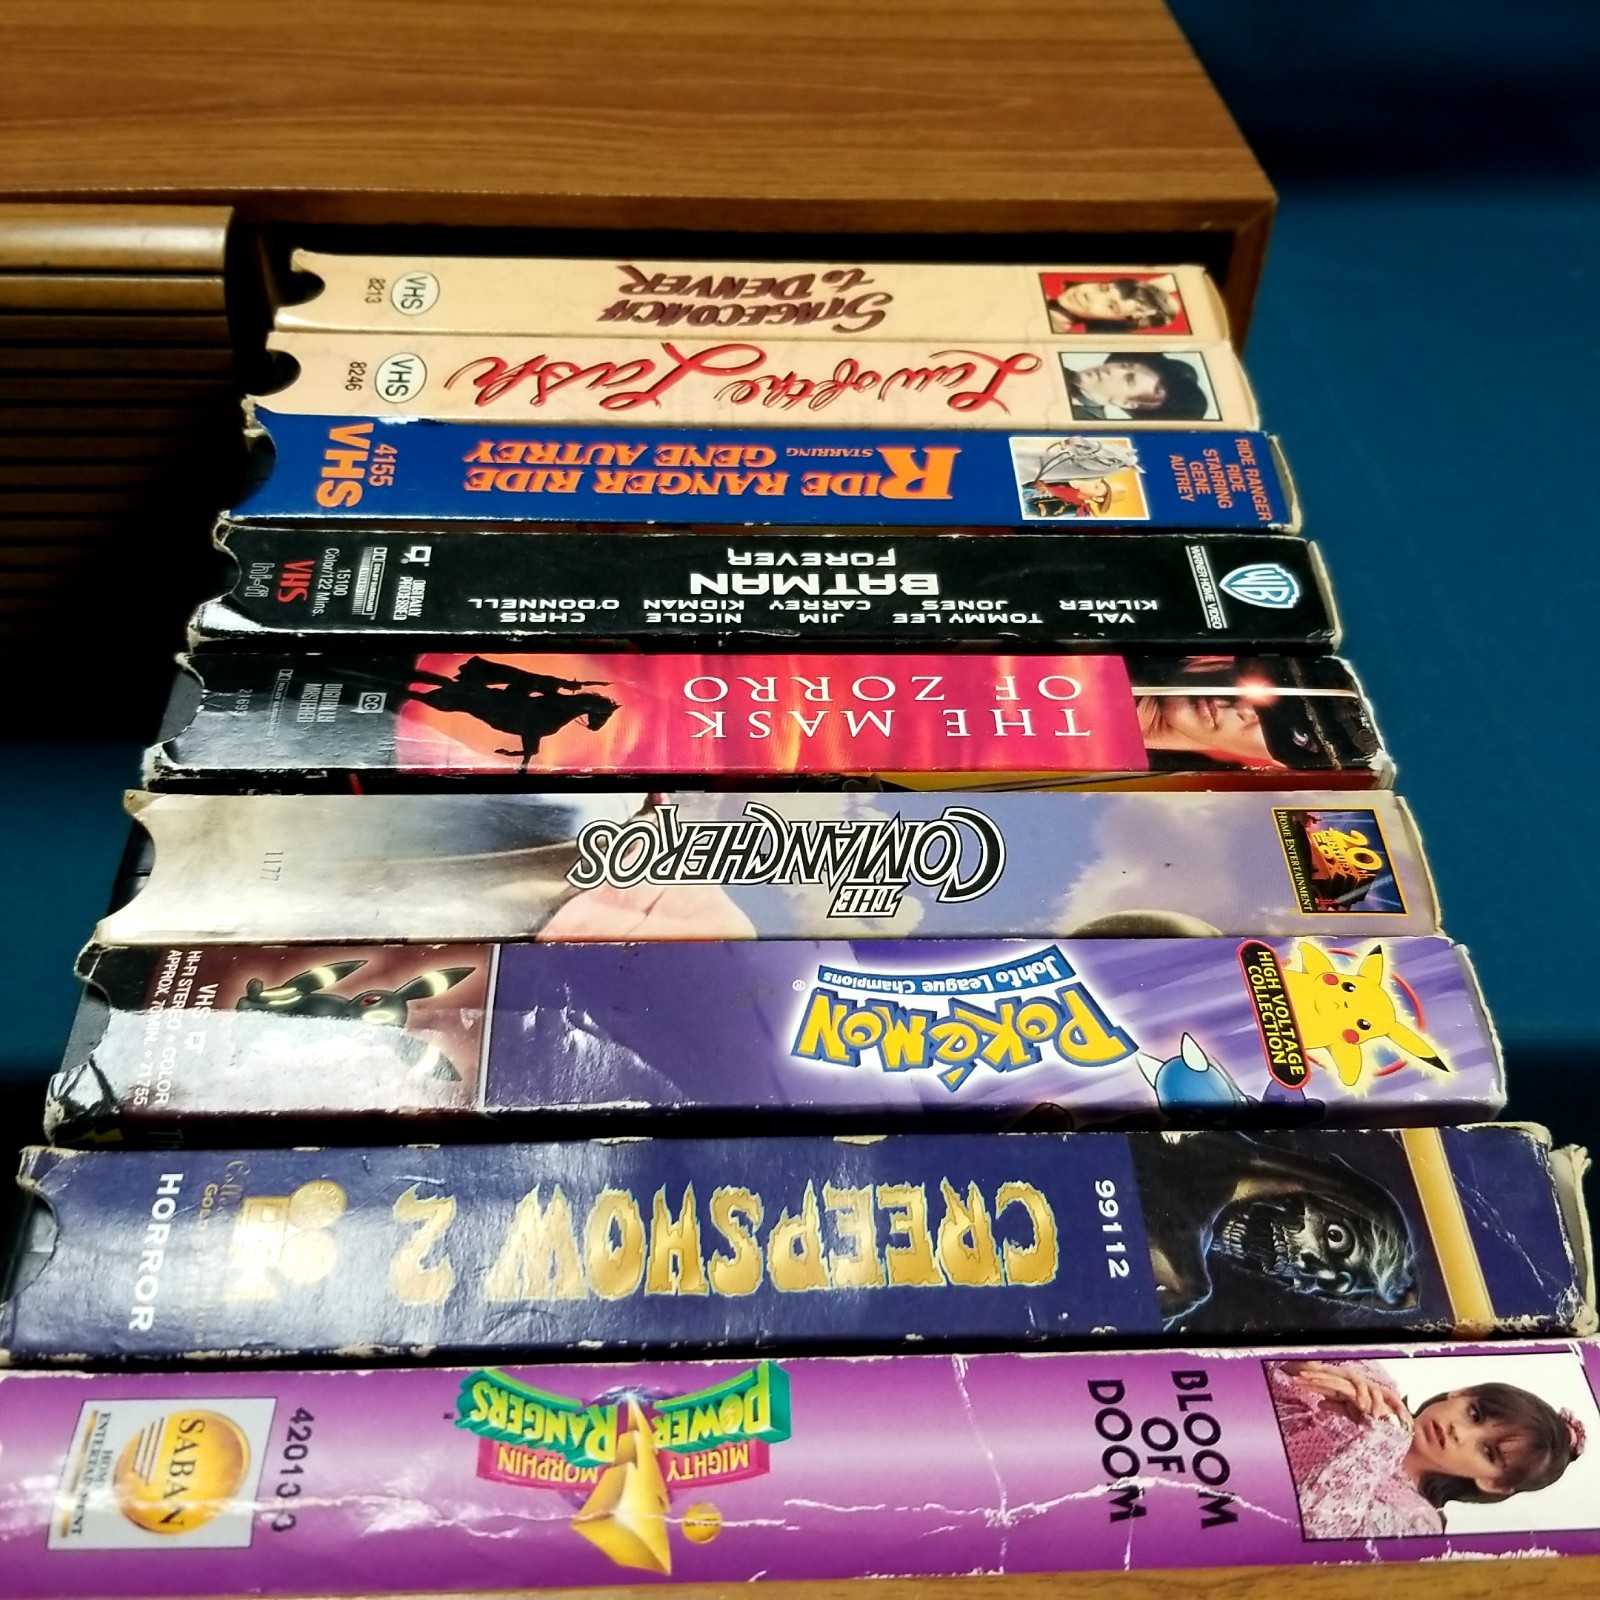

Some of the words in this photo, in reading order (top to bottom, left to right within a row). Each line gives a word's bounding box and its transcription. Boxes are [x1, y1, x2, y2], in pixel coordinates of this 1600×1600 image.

[365, 277, 385, 304] 8213
[400, 276, 429, 309] VHS
[616, 265, 817, 300] DENVER
[821, 268, 875, 292] to
[345, 361, 367, 391] 8246
[385, 358, 415, 397] VHS
[444, 342, 767, 411] Lash
[878, 350, 1042, 415] Law
[316, 422, 374, 508] VHS
[368, 443, 398, 487] 4155
[462, 440, 649, 466] AUTREY
[653, 444, 777, 468] GENE
[786, 447, 873, 458] STARRING
[1234, 438, 1256, 466] RIDE
[464, 466, 585, 493] RIDE
[592, 470, 790, 496] RANGER
[800, 445, 962, 500] RIDE
[1168, 455, 1195, 502] AUTREY
[1188, 461, 1212, 495] GENE
[1202, 448, 1234, 510] STARRING
[1225, 464, 1246, 492] RIDE
[1244, 468, 1274, 522] RANGER
[318, 547, 340, 591] Color/122
[727, 547, 896, 566] FOREVER
[244, 562, 275, 598] hi-fi
[277, 560, 316, 603] VHS
[333, 568, 352, 597] 15100
[355, 567, 370, 594] STEREO
[690, 573, 939, 596] BATMAN
[311, 591, 332, 617] Mins.
[392, 576, 413, 621] PROCESSED
[408, 579, 427, 618] DIGITALLY
[468, 598, 620, 610] O'DONNELL
[643, 599, 745, 611] KIDMAN
[769, 600, 871, 611] CARREY
[921, 600, 1009, 611] JONES
[1059, 600, 1158, 611] KILMER
[499, 612, 586, 623] CHRIS
[646, 612, 742, 624] NICOLE
[799, 613, 847, 624] JIM
[893, 613, 942, 624] LEE
[949, 613, 1044, 624] TOMMY
[1089, 613, 1135, 624] VAL
[1206, 602, 1223, 630] VIDEO
[316, 684, 343, 723] DIGITALLY
[683, 676, 945, 702] ZORRO
[996, 675, 1082, 701] OF
[685, 710, 896, 738] MASK
[942, 708, 1091, 737] THE
[565, 800, 1007, 903] COMANCHEROS
[1276, 811, 1292, 837] HOME
[1285, 838, 1312, 911] ENTERTAINMENT
[826, 884, 906, 918] THE
[154, 949, 184, 997] APPROX.
[181, 950, 204, 977] HI-FI
[995, 955, 1057, 988] Johto
[822, 971, 917, 994] Champions
[922, 974, 994, 993] League
[166, 977, 194, 1030] STEREO
[191, 983, 219, 1020] VHS
[1247, 965, 1288, 1064] COLLECTION
[1257, 951, 1280, 990] HIGH
[1271, 995, 1305, 1076] VOLTAGE
[133, 1063, 154, 1107] 71755
[154, 1047, 177, 1105] COLOR
[389, 1182, 456, 1306] 2
[484, 1177, 1060, 1301] CREEPSHOW
[1095, 1179, 1131, 1279] 99112
[128, 1173, 184, 1332] HORROR
[653, 1360, 775, 1448] POWER
[472, 1381, 618, 1463] RANGERS
[1087, 1379, 1147, 1523] DOOM
[1141, 1417, 1186, 1473] OF
[1171, 1370, 1239, 1529] BLOOM
[94, 1449, 114, 1489] HOM
[158, 1417, 205, 1527] SABAN
[497, 1446, 598, 1484] MORPHIN
[666, 1444, 750, 1482] MIGHTY
